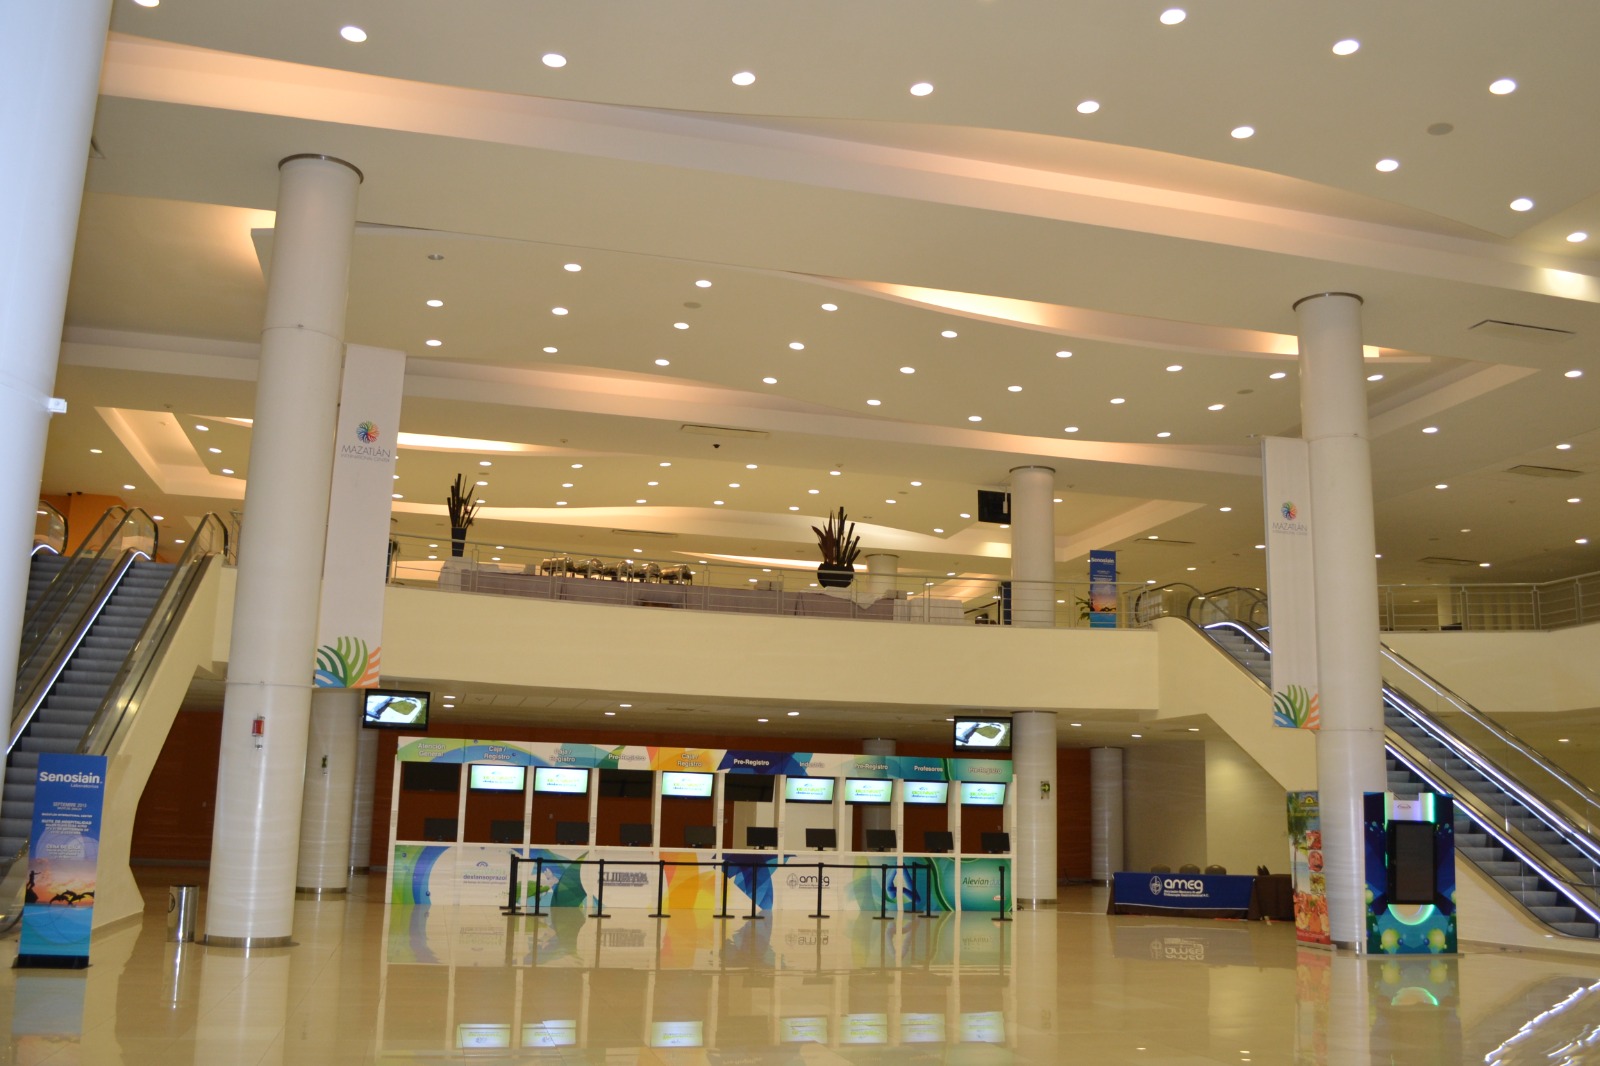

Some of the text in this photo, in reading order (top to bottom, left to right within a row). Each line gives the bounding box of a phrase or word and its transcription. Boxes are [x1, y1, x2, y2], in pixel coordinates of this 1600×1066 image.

[342, 445, 390, 457] MAZATLÁN
[483, 752, 511, 760] Registro
[608, 754, 647, 762] Pre-Registro
[677, 760, 702, 768] Registro
[733, 758, 770, 766] Pre-Registro
[39, 771, 100, 783] Senosiain
[799, 875, 830, 887] amg
[962, 877, 990, 886] Alevian
[1163, 878, 1203, 894] ameg
